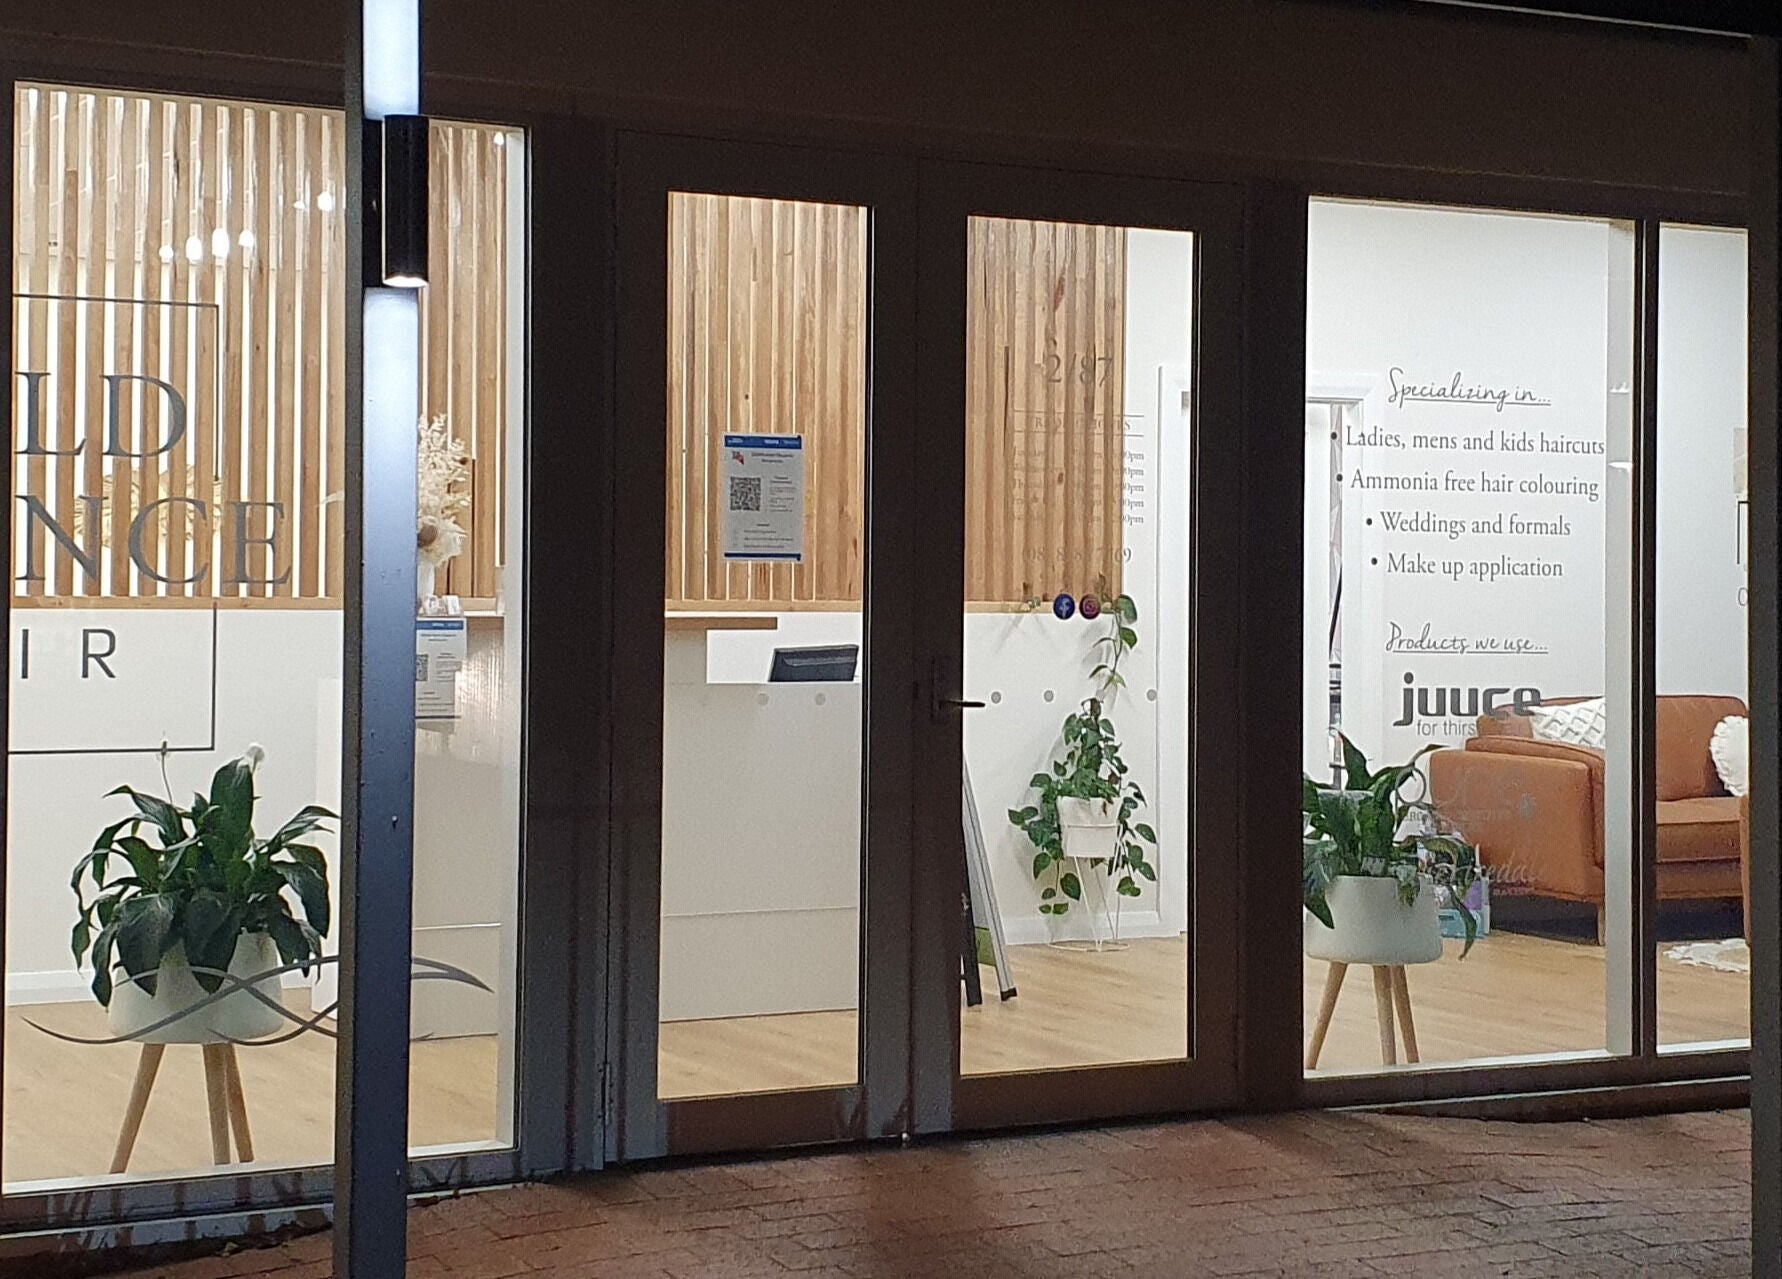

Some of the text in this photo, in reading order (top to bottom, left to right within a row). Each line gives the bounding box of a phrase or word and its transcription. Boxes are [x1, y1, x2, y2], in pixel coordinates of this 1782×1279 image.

[1388, 367, 1510, 412] Specializing
[1346, 425, 1605, 454] Ladies, mens and kids haircuts
[1350, 468, 1600, 502] Ammonia free hair colouring
[1380, 511, 1572, 540] Weddings and formals
[1387, 552, 1564, 582] Make up application
[1386, 621, 1470, 655] Products
[1475, 637, 1500, 651] we
[1393, 671, 1541, 727] juuce
[1417, 719, 1476, 736] for thirs
